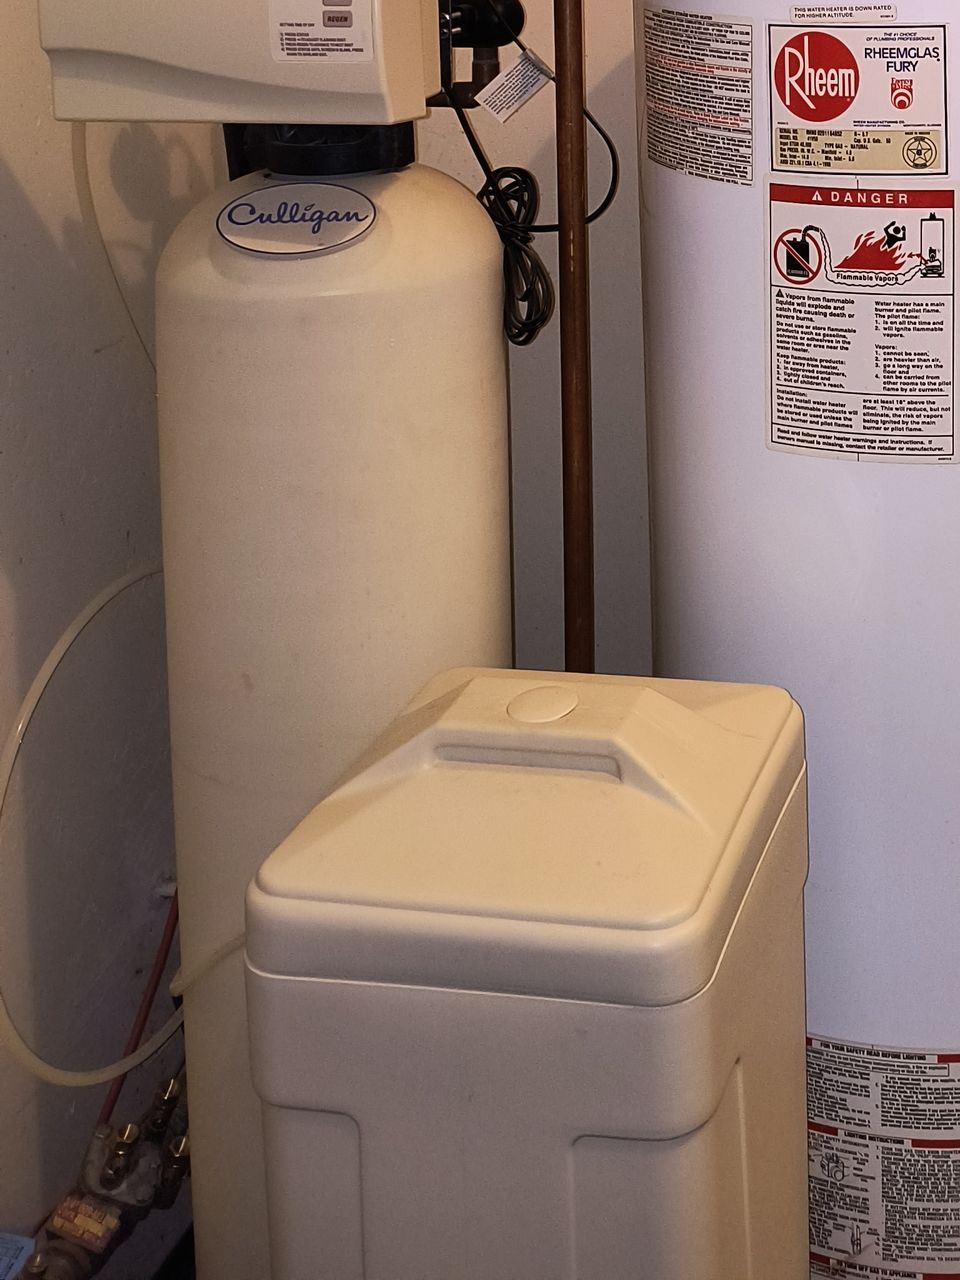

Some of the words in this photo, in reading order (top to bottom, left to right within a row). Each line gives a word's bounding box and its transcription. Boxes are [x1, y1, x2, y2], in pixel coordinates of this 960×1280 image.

[784, 36, 854, 109] Rheem
[887, 61, 918, 72] FURY
[831, 192, 908, 204] DANGER
[228, 202, 369, 234] Culligan
